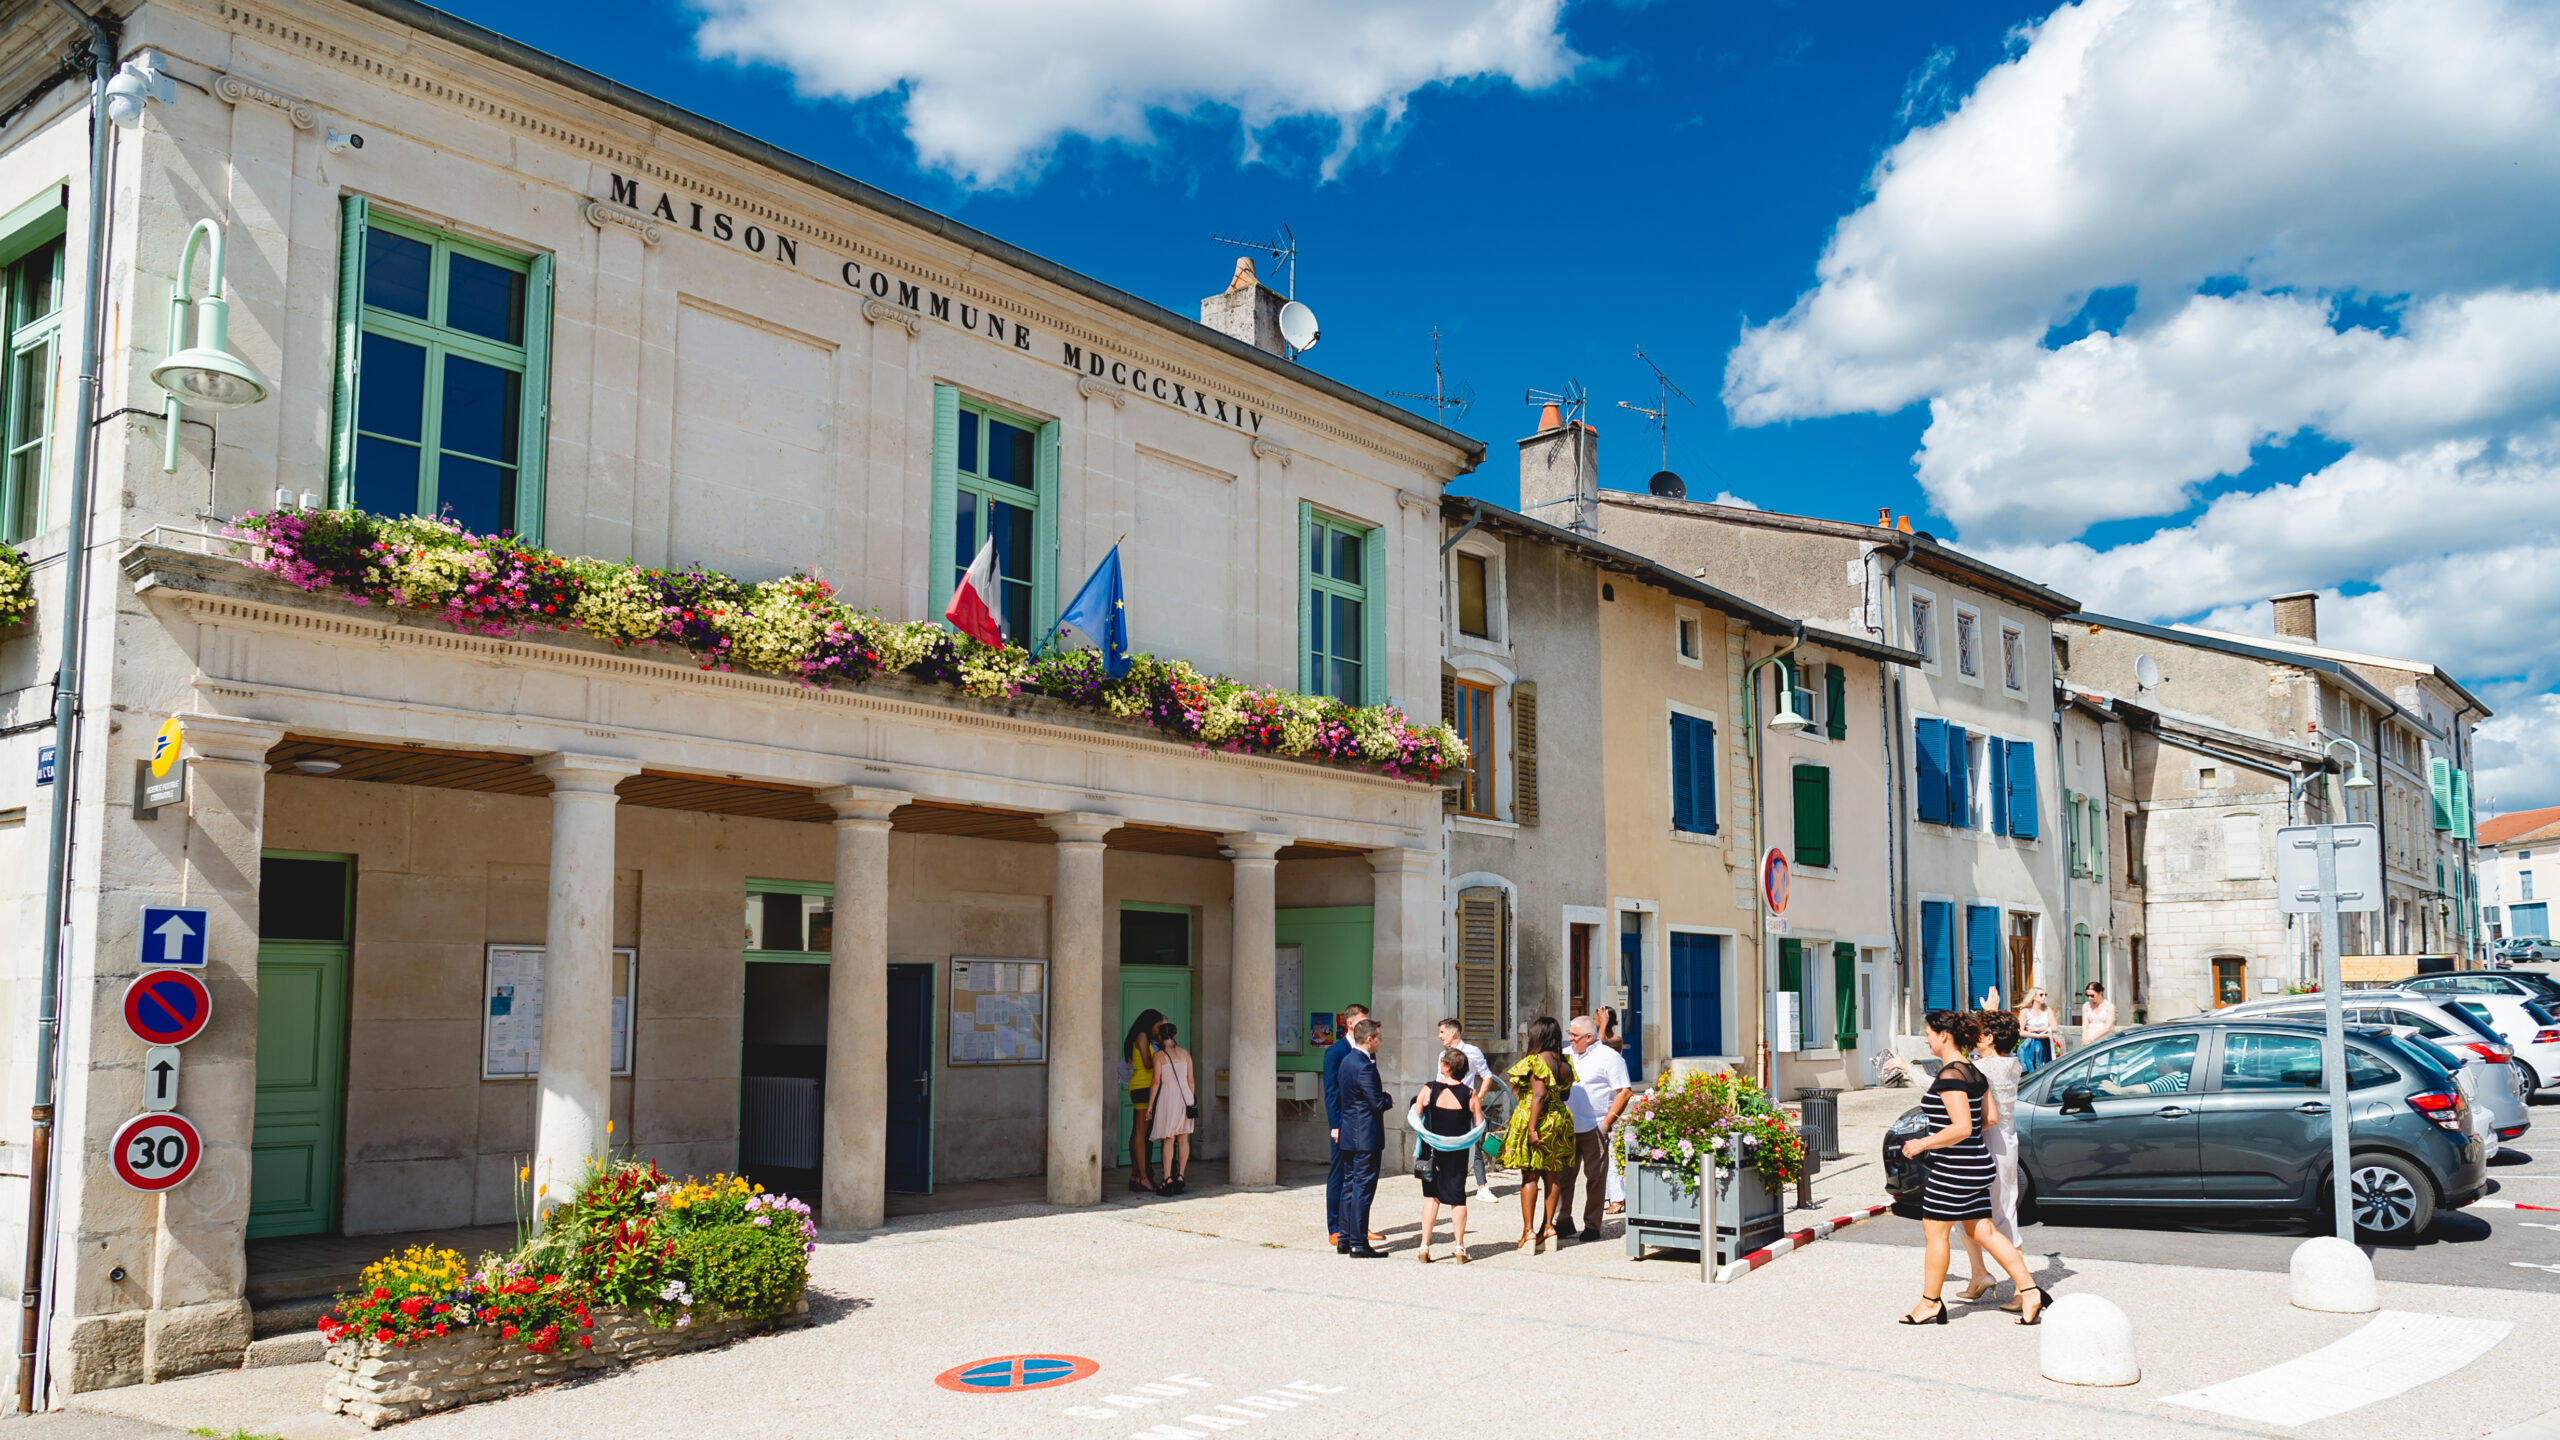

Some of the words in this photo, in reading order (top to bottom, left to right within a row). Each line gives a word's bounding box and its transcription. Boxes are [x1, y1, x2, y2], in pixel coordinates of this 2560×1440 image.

[610, 173, 798, 266] MAISON
[842, 261, 1030, 350] COMMUNE
[1063, 342, 1263, 433] MDCCCXXXIV
[41, 750, 55, 762] RUE
[130, 1135, 184, 1170] 30
[1062, 1373, 1213, 1420] SAUF
